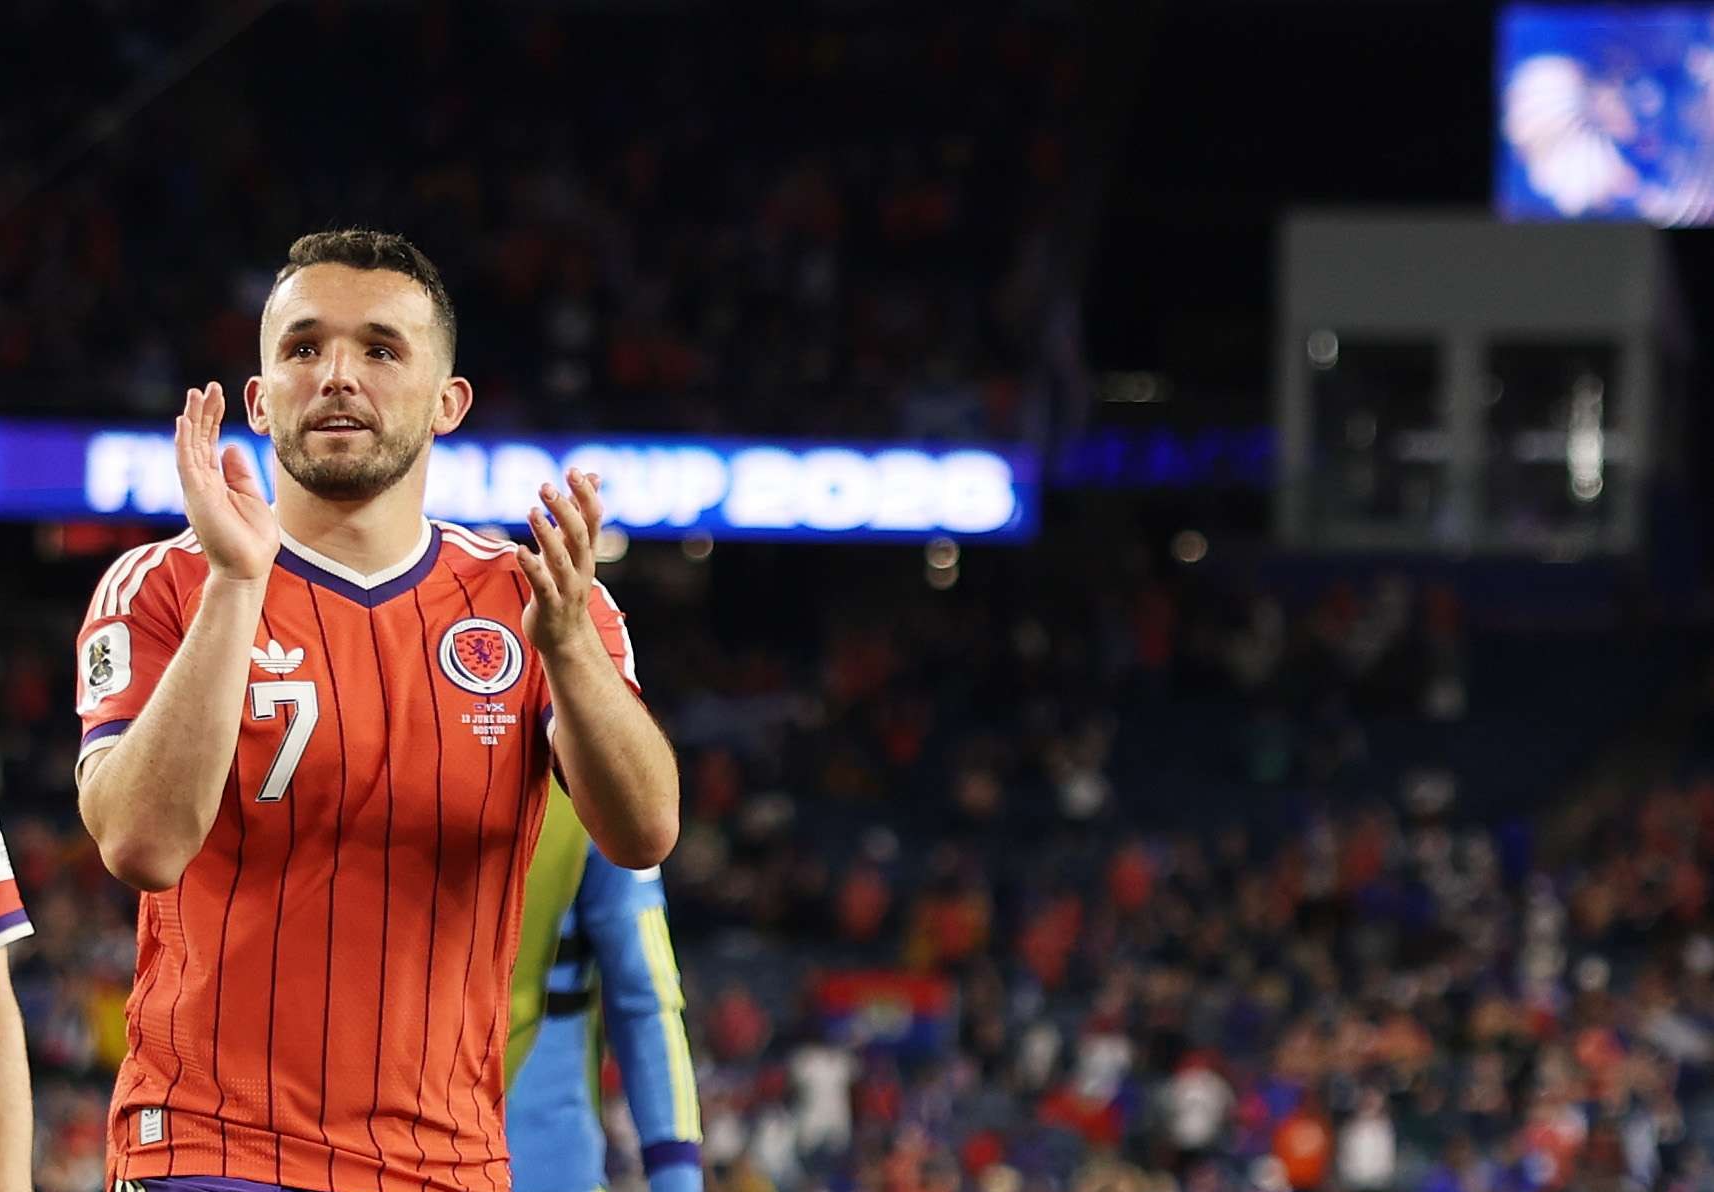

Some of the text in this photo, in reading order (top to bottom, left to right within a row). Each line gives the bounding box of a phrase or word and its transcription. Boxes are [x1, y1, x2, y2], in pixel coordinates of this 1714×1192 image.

[723, 446, 1017, 534] 2026
[472, 714, 495, 724] JUNE
[472, 725, 506, 735] BOSTON
[250, 681, 319, 802] 7
[480, 735, 499, 745] USA
